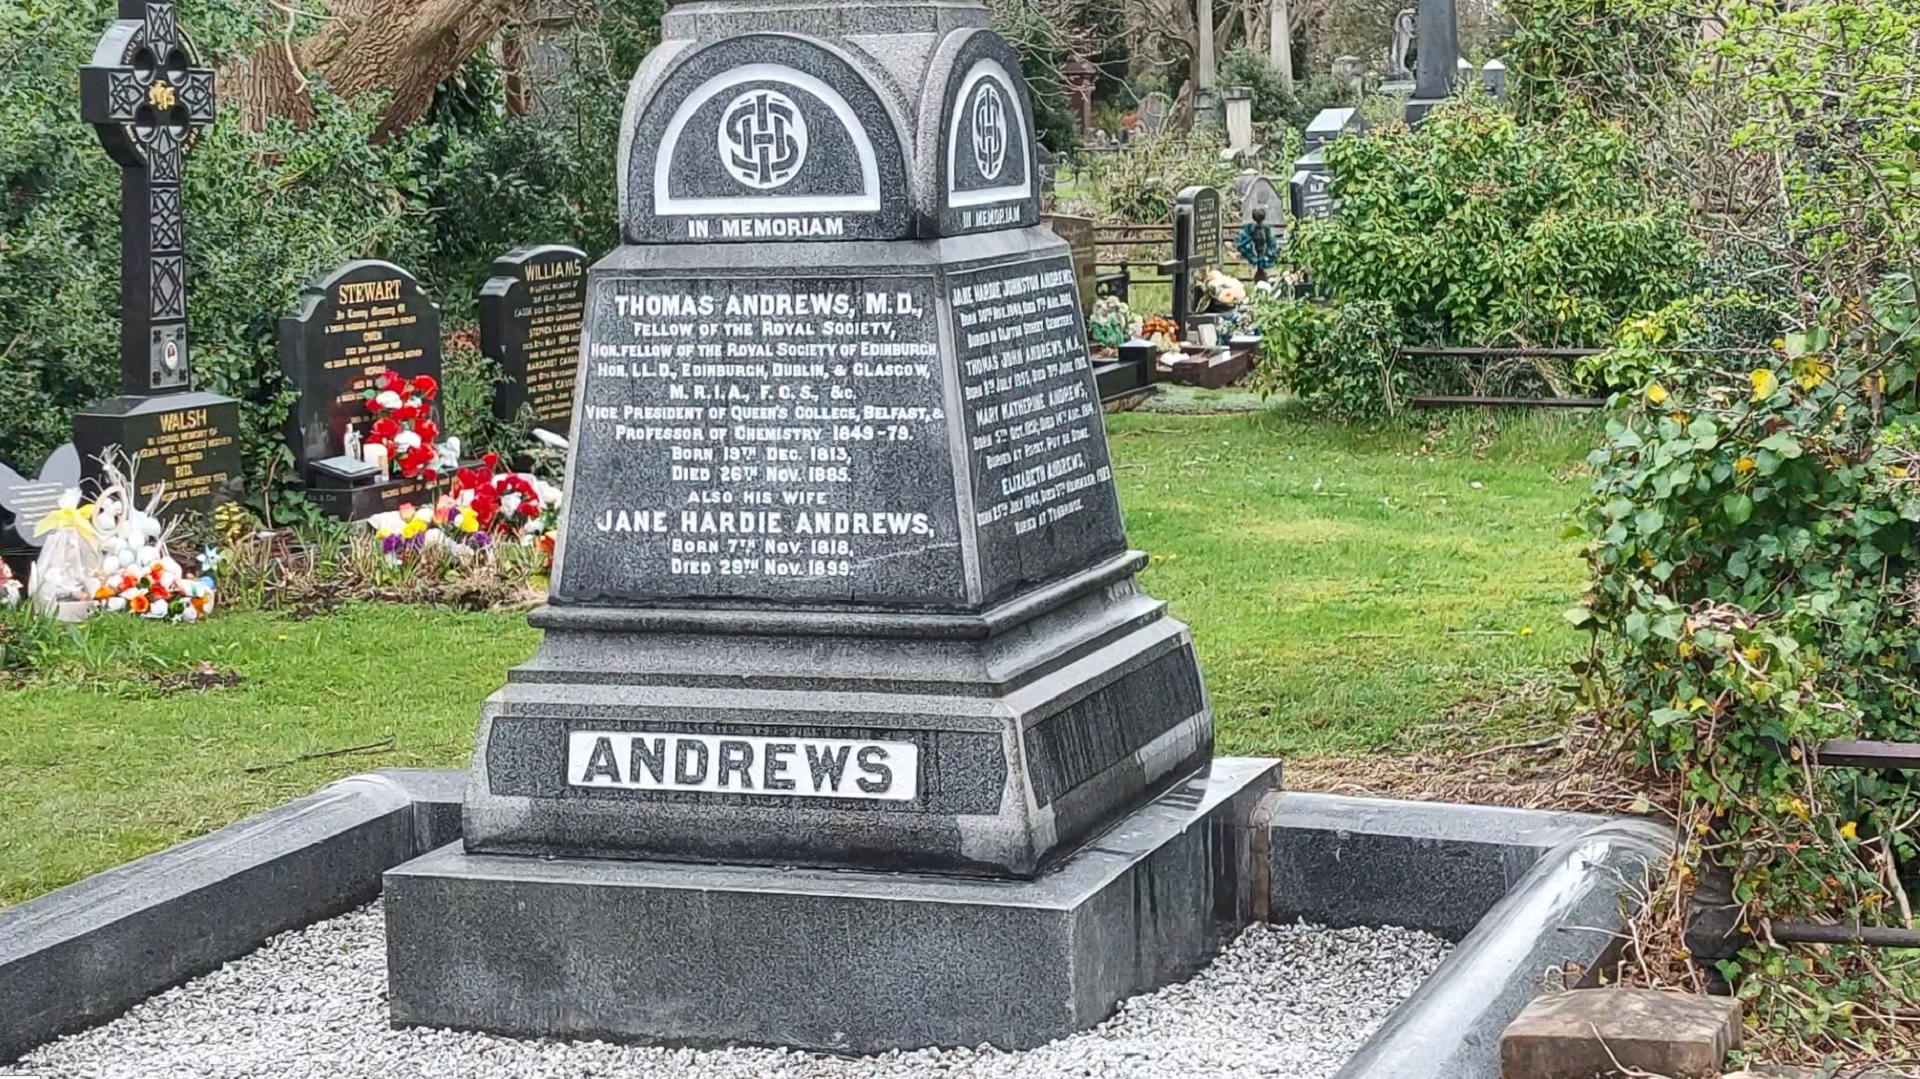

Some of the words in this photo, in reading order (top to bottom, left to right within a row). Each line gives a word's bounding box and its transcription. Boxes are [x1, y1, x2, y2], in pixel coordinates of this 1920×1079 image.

[689, 219, 709, 237] IN
[722, 217, 843, 238] MEMORIAM
[525, 258, 582, 282] WILLIAMS
[338, 279, 403, 305] STEWART
[615, 293, 714, 316] THOMAS
[725, 293, 856, 318] ANDREWS,
[634, 322, 692, 337] FELLOW
[700, 323, 719, 337] OF
[724, 323, 752, 337] THE
[762, 322, 815, 337] ROYAL
[822, 322, 897, 340] SOCIETY,
[677, 344, 696, 358] OF
[698, 344, 722, 358] THE
[727, 343, 773, 358] ROYAL
[777, 343, 837, 358] SOCIETY
[840, 343, 858, 358] OF
[860, 342, 937, 358] EDINBURGH
[682, 363, 768, 380] EDINBURGH,
[773, 363, 830, 381] DUBLIN,
[834, 365, 846, 378] &
[853, 363, 931, 381] GLASGOW,
[160, 408, 207, 433] WALSH
[585, 406, 617, 422] VICE
[623, 406, 702, 422] PRESIDENT
[709, 406, 726, 422] OF
[795, 406, 861, 424] COLLEGE,
[615, 425, 706, 441] PROFESSOR
[710, 426, 727, 441] OF
[734, 425, 822, 441] CHEMISTRY
[671, 446, 714, 461] BORN
[766, 446, 802, 461] DEC.
[671, 466, 711, 482] DIED
[766, 466, 803, 482] NOV.
[808, 466, 852, 482] 1885.
[687, 491, 732, 504] ALSO
[743, 491, 772, 504] HIS
[782, 491, 827, 505] WIFE
[596, 510, 668, 533] JANE
[681, 511, 781, 534] HARDIE
[795, 512, 935, 538] ANDREWS,
[671, 539, 719, 554] BORN
[765, 539, 803, 555] NOV.
[671, 559, 712, 575] DIED
[765, 559, 804, 575] NOV.
[808, 559, 854, 576] 1899.
[582, 736, 894, 794] ANDREWS
